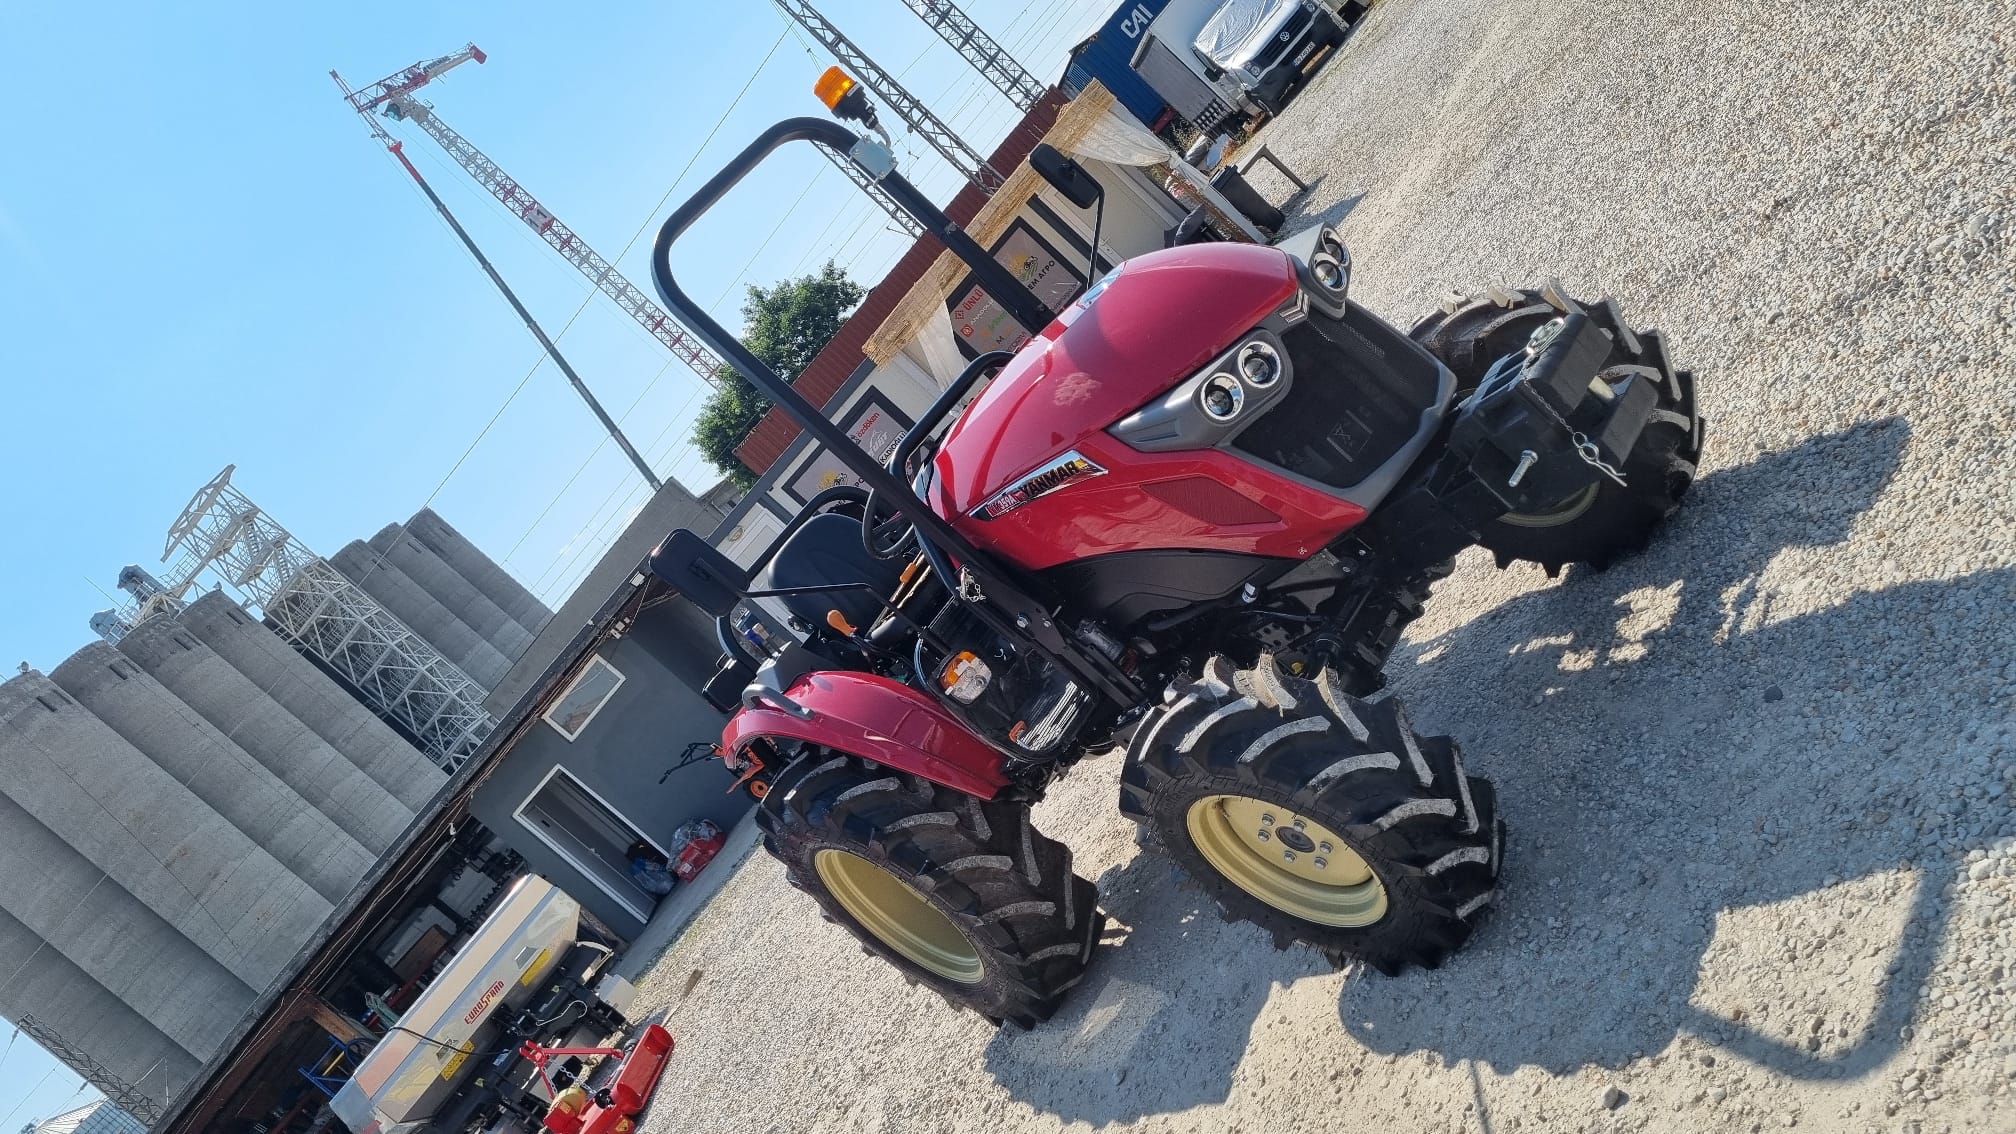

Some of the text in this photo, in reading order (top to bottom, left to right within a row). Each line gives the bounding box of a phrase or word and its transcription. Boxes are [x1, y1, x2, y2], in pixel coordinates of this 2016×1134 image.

[1120, 3, 1154, 38] CAI
[1038, 260, 1055, 279] АГРО
[962, 288, 984, 311] ÜNLÜ
[855, 412, 880, 438] özdöken
[1018, 460, 1078, 498] YANMAR
